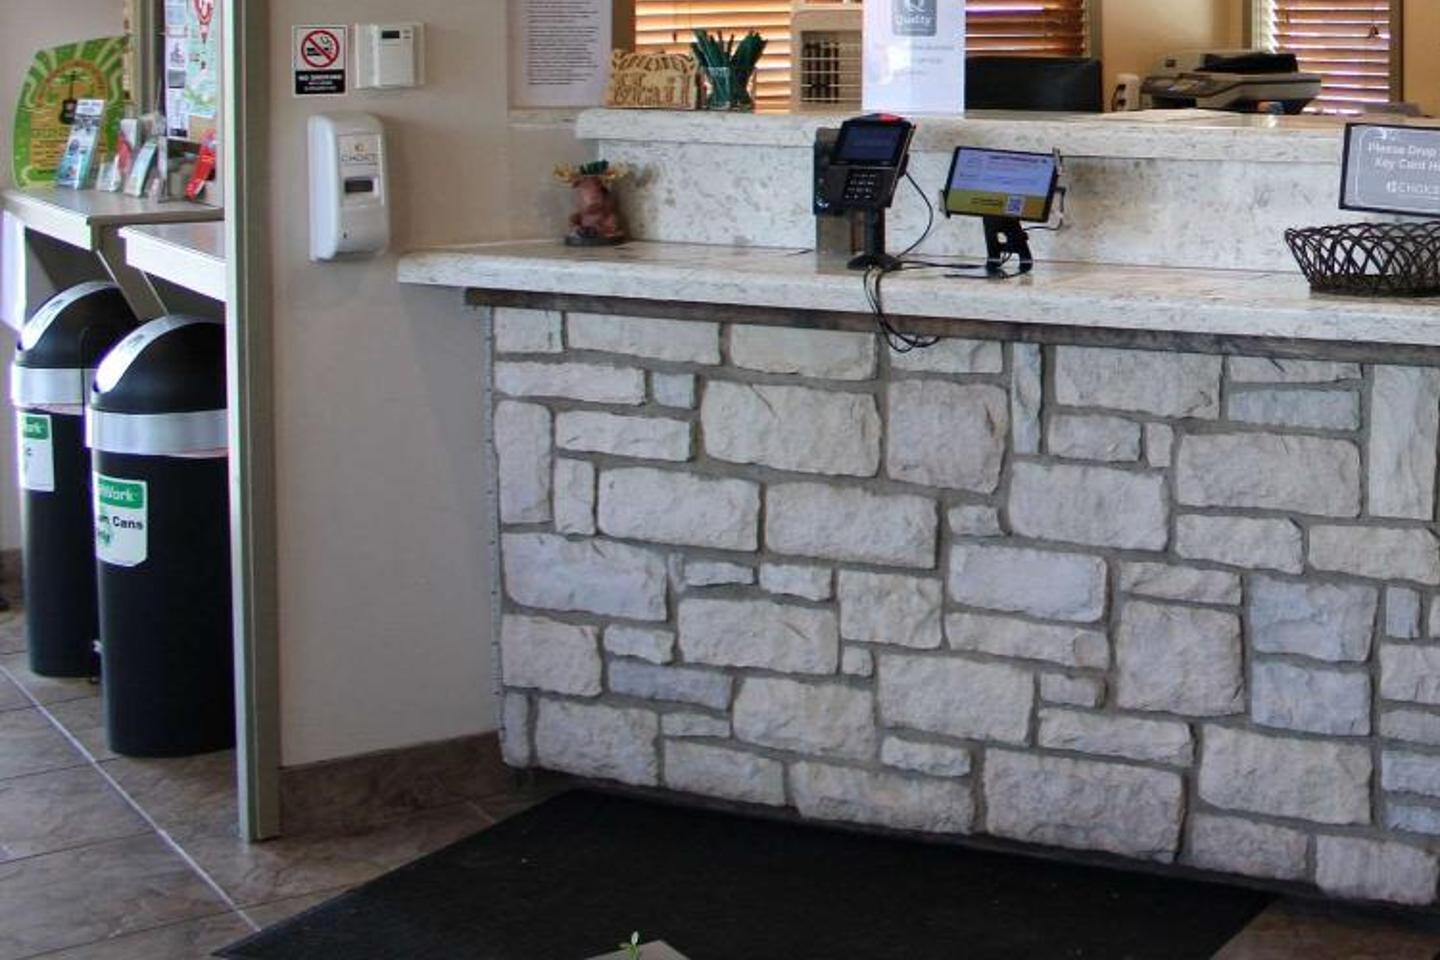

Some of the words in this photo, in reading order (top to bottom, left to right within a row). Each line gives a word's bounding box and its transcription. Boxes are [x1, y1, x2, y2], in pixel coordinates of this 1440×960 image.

[1368, 141, 1405, 155] Please
[1407, 145, 1437, 159] Drop
[1374, 157, 1396, 171] Key
[1399, 158, 1427, 171] Card
[112, 515, 144, 530] Cans
